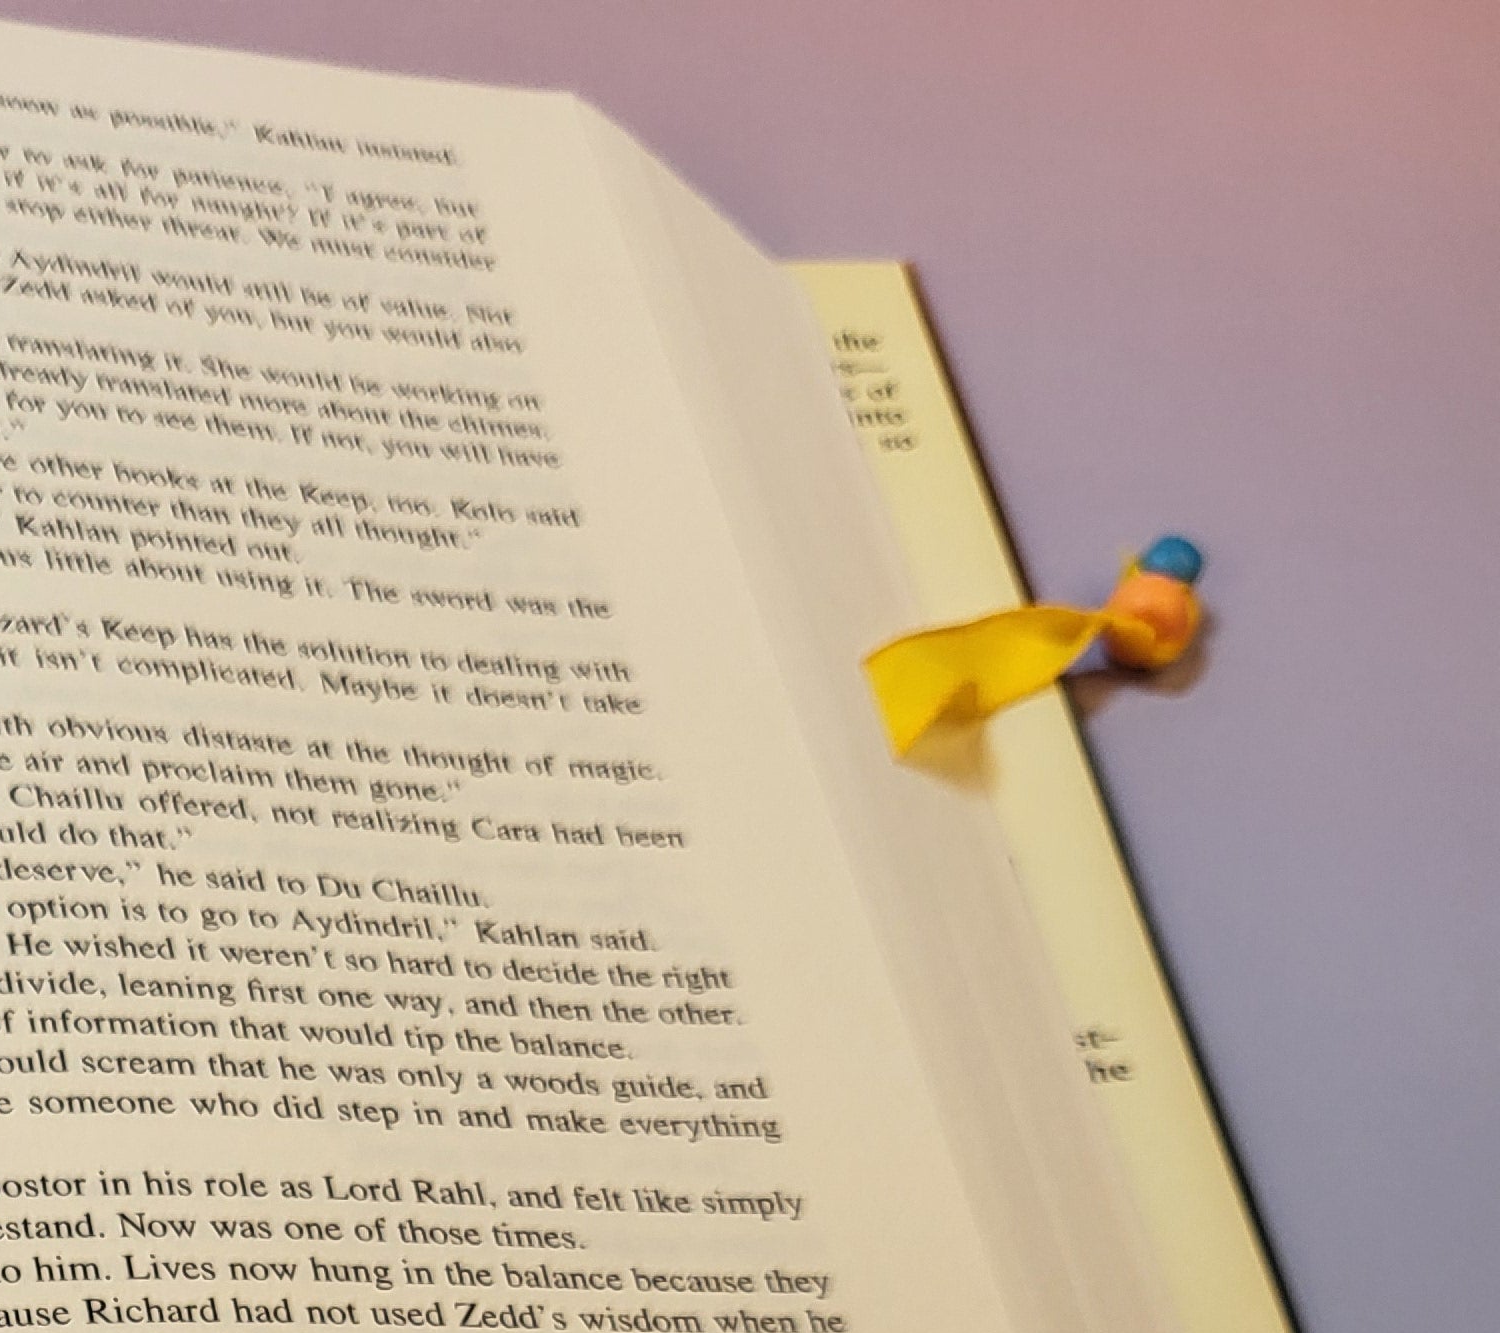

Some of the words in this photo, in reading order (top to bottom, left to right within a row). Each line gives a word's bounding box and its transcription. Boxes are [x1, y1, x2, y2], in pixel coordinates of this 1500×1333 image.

[47, 714, 171, 745] obvious
[181, 721, 296, 756] distaste
[306, 739, 334, 761] at
[345, 737, 391, 765] the
[402, 743, 513, 779] thought
[524, 753, 557, 777] of
[98, 1169, 133, 1197] in
[141, 1169, 193, 1197] his
[203, 1170, 269, 1198] role
[279, 1179, 314, 1200] as
[321, 1173, 403, 1203] Lord
[410, 1177, 497, 1211] Rahl,
[507, 1183, 565, 1210] and
[573, 1185, 628, 1212] felt
[631, 1185, 695, 1214] like
[701, 1189, 805, 1222] simply
